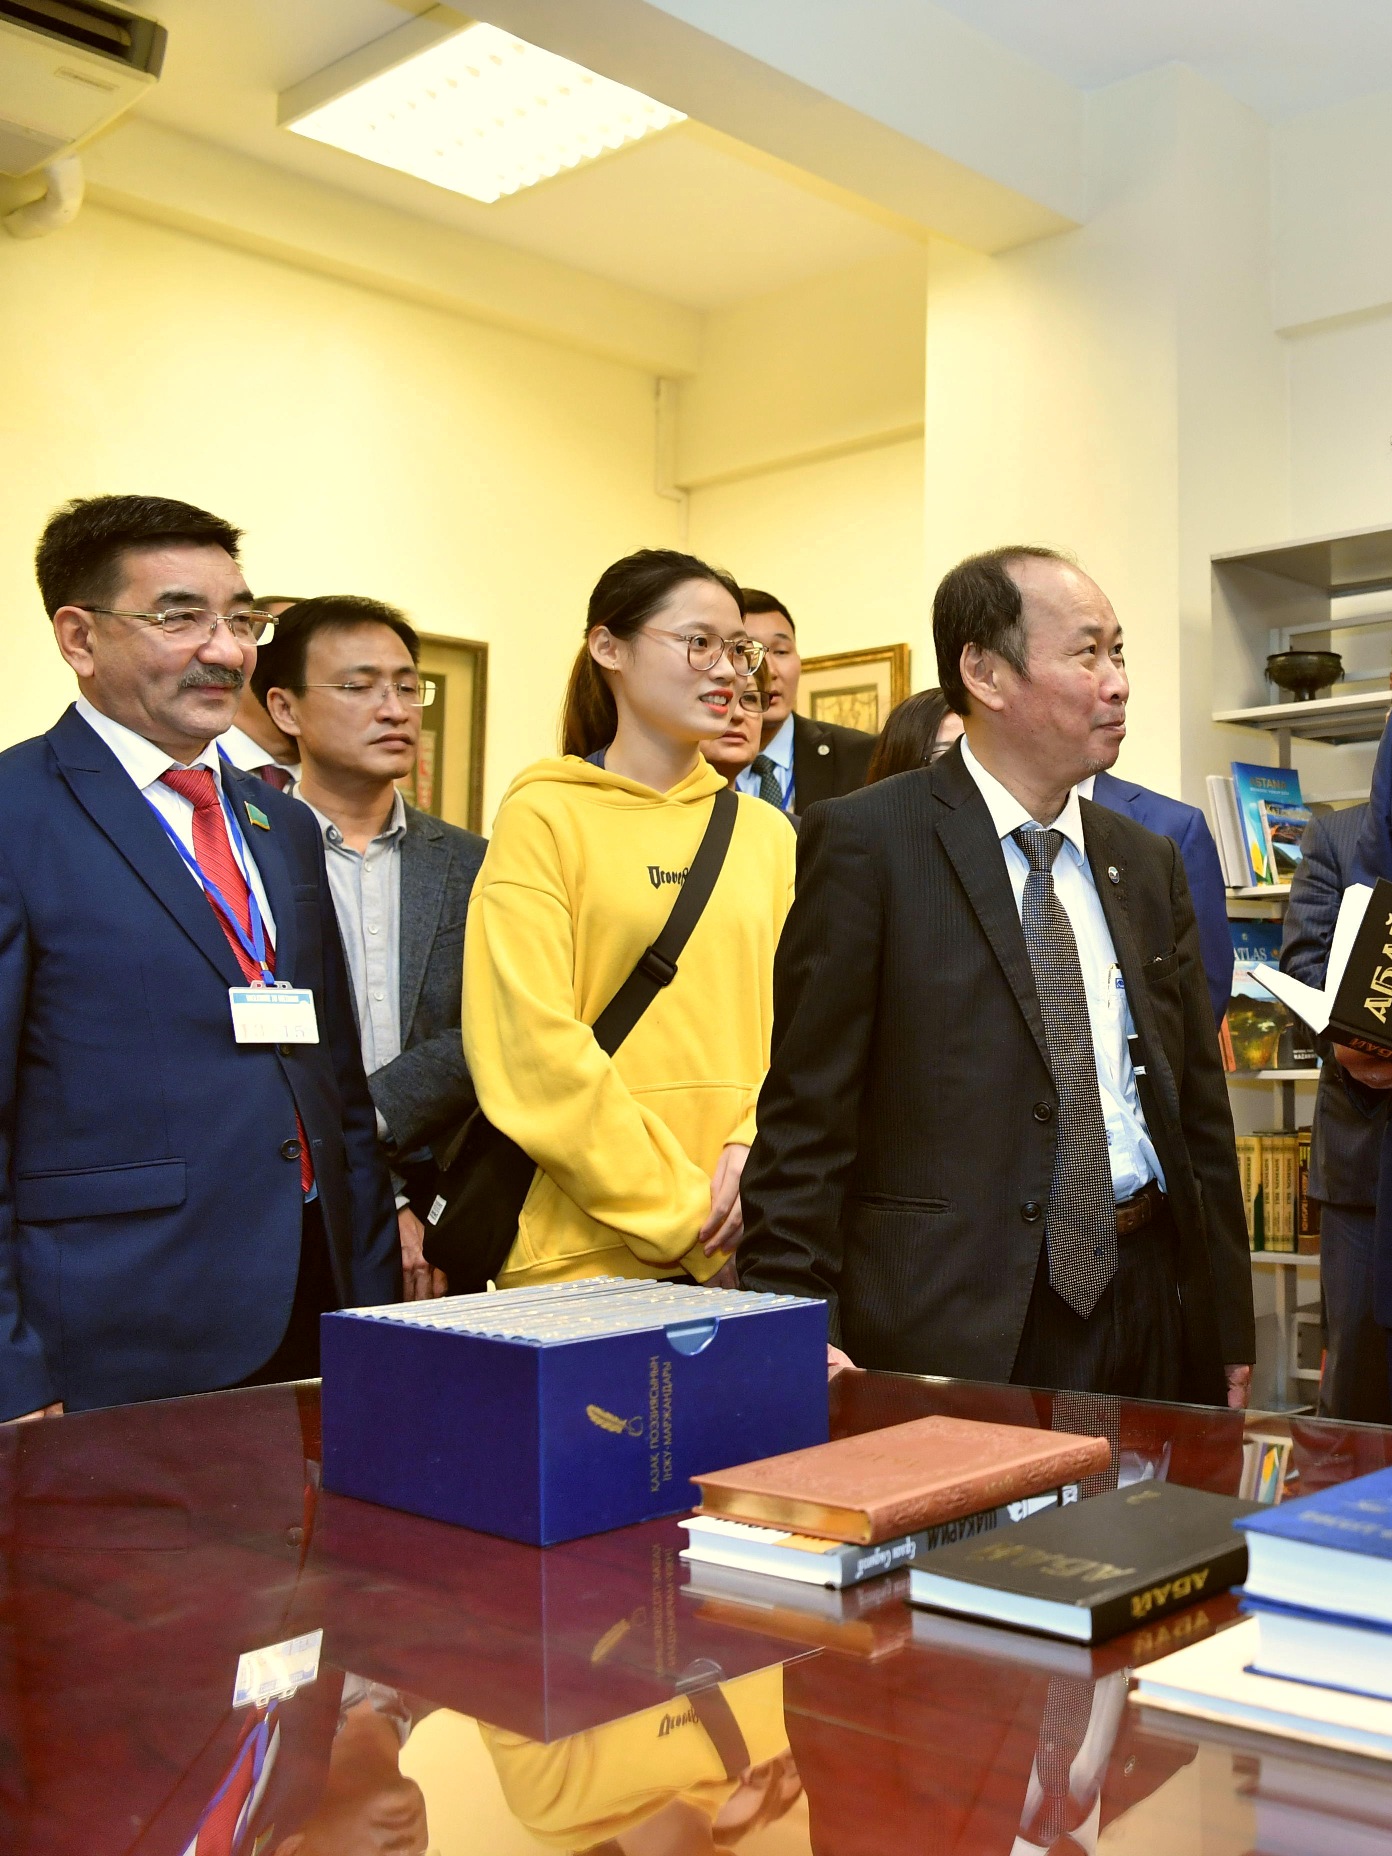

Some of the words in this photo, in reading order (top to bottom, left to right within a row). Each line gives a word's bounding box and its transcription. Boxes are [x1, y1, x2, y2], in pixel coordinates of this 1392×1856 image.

[1233, 947, 1268, 962] ATLAS
[927, 1509, 998, 1551] ШАКАРИМ
[1130, 1567, 1210, 1620] АБАЙ
